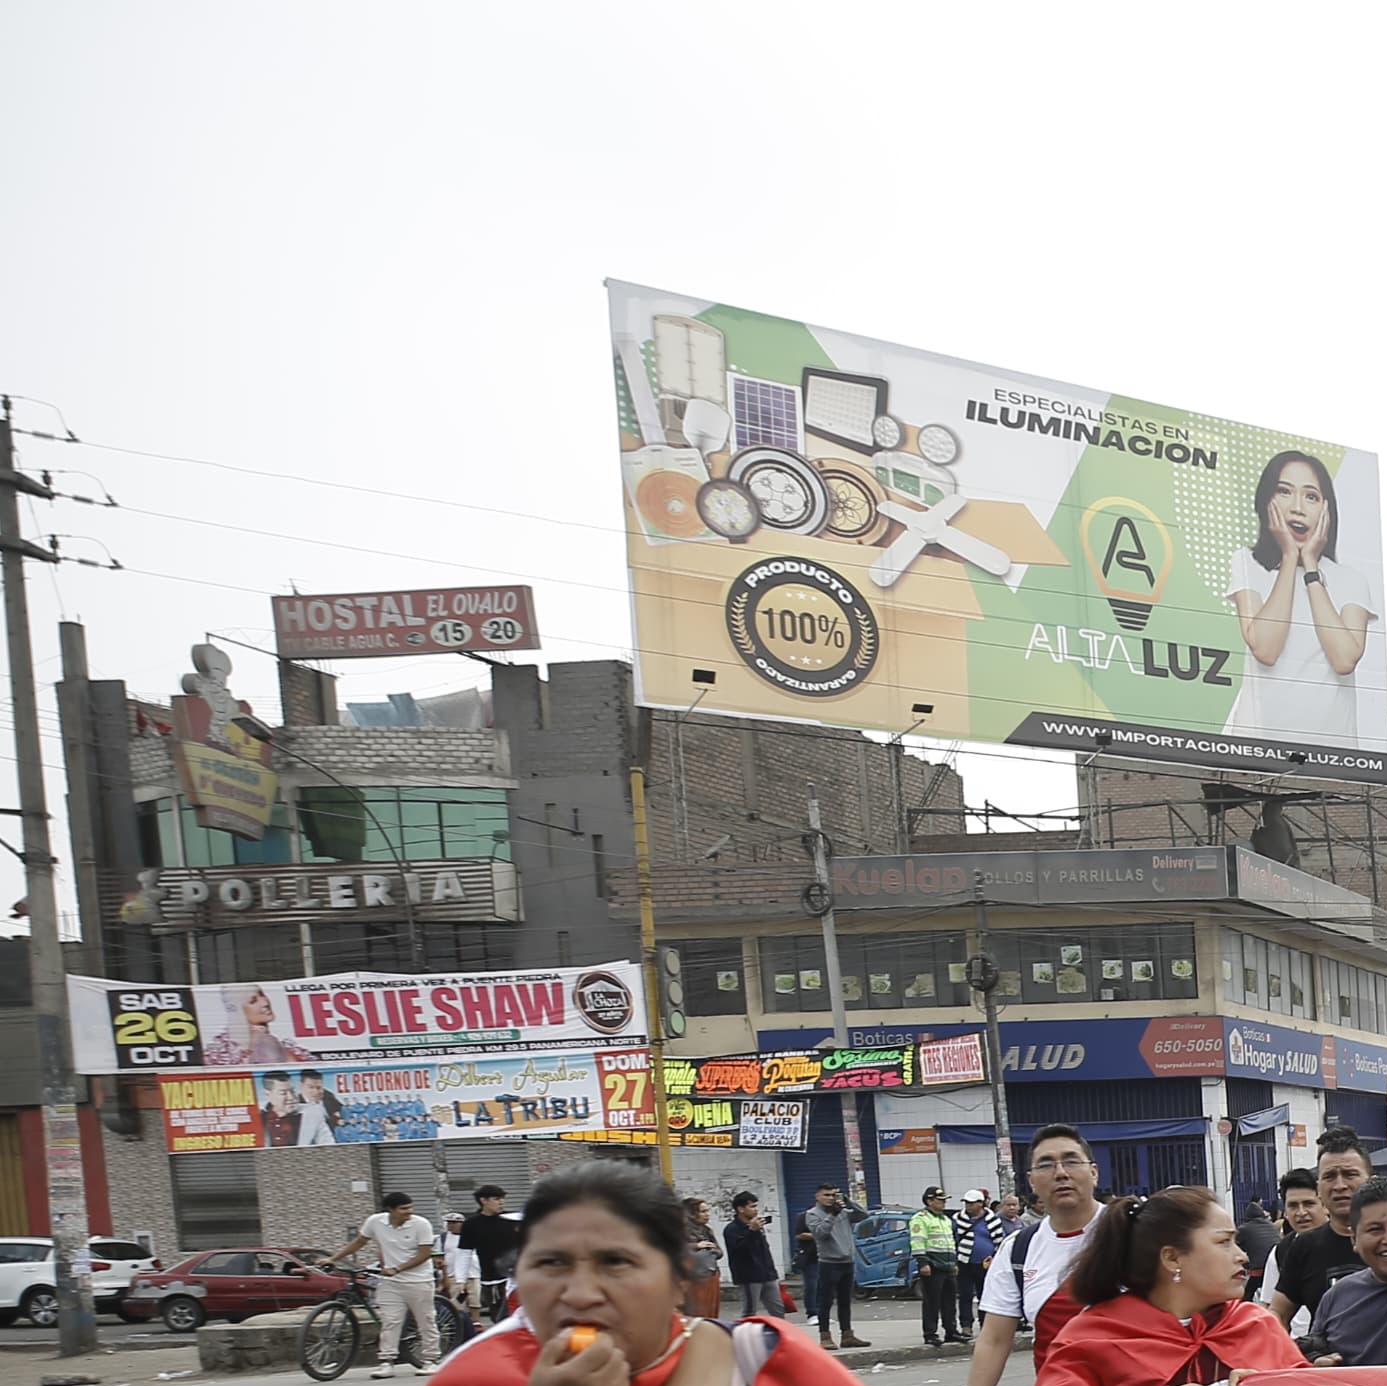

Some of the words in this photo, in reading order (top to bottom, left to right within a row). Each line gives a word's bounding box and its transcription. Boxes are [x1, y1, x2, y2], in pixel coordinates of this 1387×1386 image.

[994, 389, 1158, 435] ESPECIALISTAS
[1163, 426, 1189, 441] EN
[744, 560, 854, 604] PRODUCTO
[279, 595, 427, 632] HOSTAL
[427, 594, 449, 617] EL
[453, 591, 517, 615] OVALO
[439, 623, 464, 642] 15
[490, 621, 516, 640] 20
[762, 608, 845, 648] 100%
[303, 636, 345, 650] CABLE
[350, 634, 384, 648] AGUA
[755, 658, 857, 691] GARANTIZADO
[1152, 856, 1194, 871] Delivery
[832, 860, 967, 897] Kuelap
[974, 870, 1034, 885] OLLOS
[1043, 869, 1053, 883] Y
[1058, 868, 1144, 883] PARRILLAS
[284, 984, 327, 993] LLEGA
[330, 982, 357, 991] POR
[360, 980, 417, 989] PRIMERA
[422, 978, 446, 987] VEZ
[451, 978, 459, 986] A
[119, 992, 183, 1011] SAB
[287, 989, 428, 1038] LESLIE
[431, 982, 565, 1031] SHAW
[113, 1010, 198, 1045] 26
[1242, 1026, 1265, 1042] Boticas
[386, 1050, 401, 1058] DE
[403, 1048, 445, 1057] PUENTE
[485, 1044, 502, 1053] KM
[505, 1042, 528, 1051] 29.5
[529, 1039, 608, 1051] PANAMERICANA
[610, 1036, 641, 1046] NORTE
[853, 1031, 914, 1047] Boticas
[1154, 1038, 1223, 1054] 650-5050
[130, 1045, 193, 1064] OCT
[603, 1055, 650, 1071] DOM.
[1001, 1044, 1085, 1072] ALUD
[1244, 1044, 1276, 1073] Hogar
[1276, 1055, 1285, 1076] y
[1285, 1051, 1318, 1075] SALUD
[1355, 1053, 1378, 1074] Boticas
[337, 1073, 350, 1094] EL
[353, 1070, 408, 1093] RETORNO
[410, 1069, 430, 1090] DE
[604, 1072, 647, 1111] 27
[161, 1078, 256, 1110] YACUMAMA
[451, 1100, 491, 1128] LA
[495, 1094, 590, 1124] TRIBU
[609, 1110, 641, 1127] OCT.
[694, 1100, 735, 1128] PEÑA
[743, 1102, 801, 1117] PALACIO
[754, 1118, 793, 1126] CLUB
[173, 1135, 223, 1151] INGRESO
